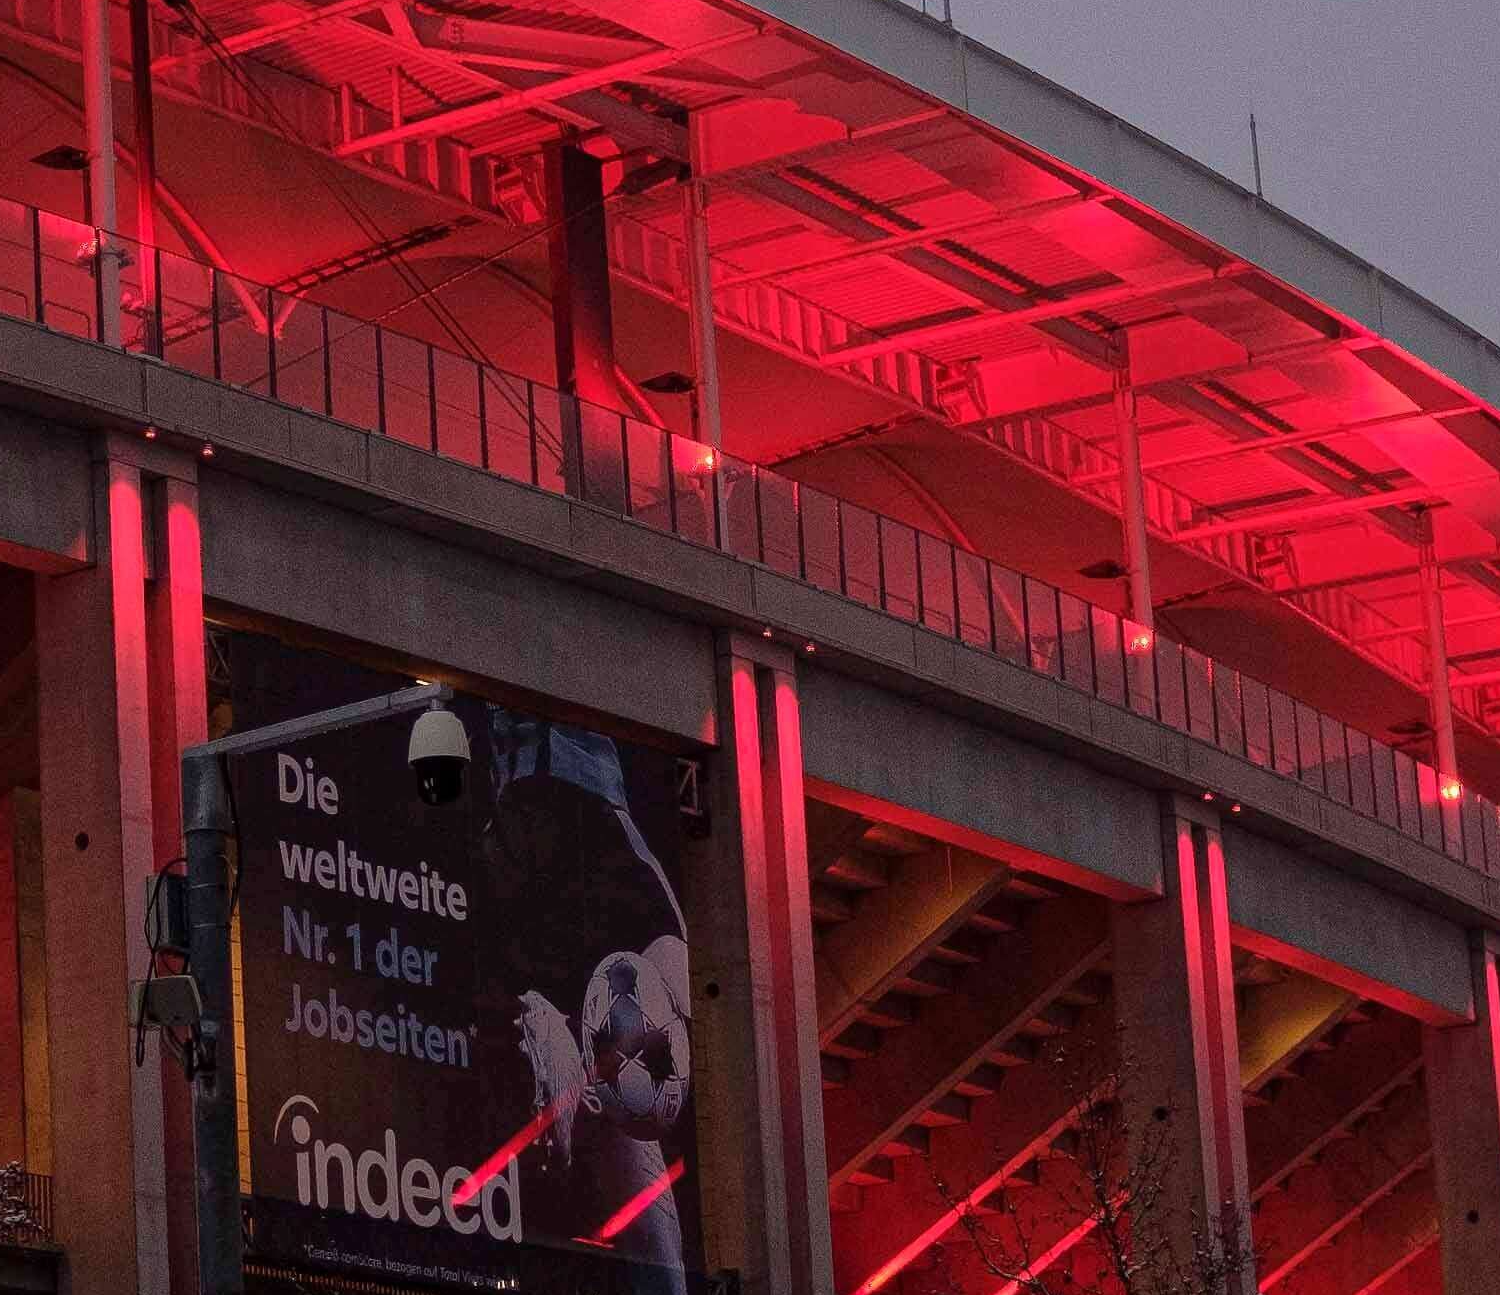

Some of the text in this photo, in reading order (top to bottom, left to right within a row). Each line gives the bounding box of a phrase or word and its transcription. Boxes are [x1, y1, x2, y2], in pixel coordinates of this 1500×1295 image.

[277, 753, 340, 815] Die
[279, 839, 468, 921] weltweite
[282, 905, 439, 986] Nr. 1 der
[292, 1115, 522, 1243] indeed
